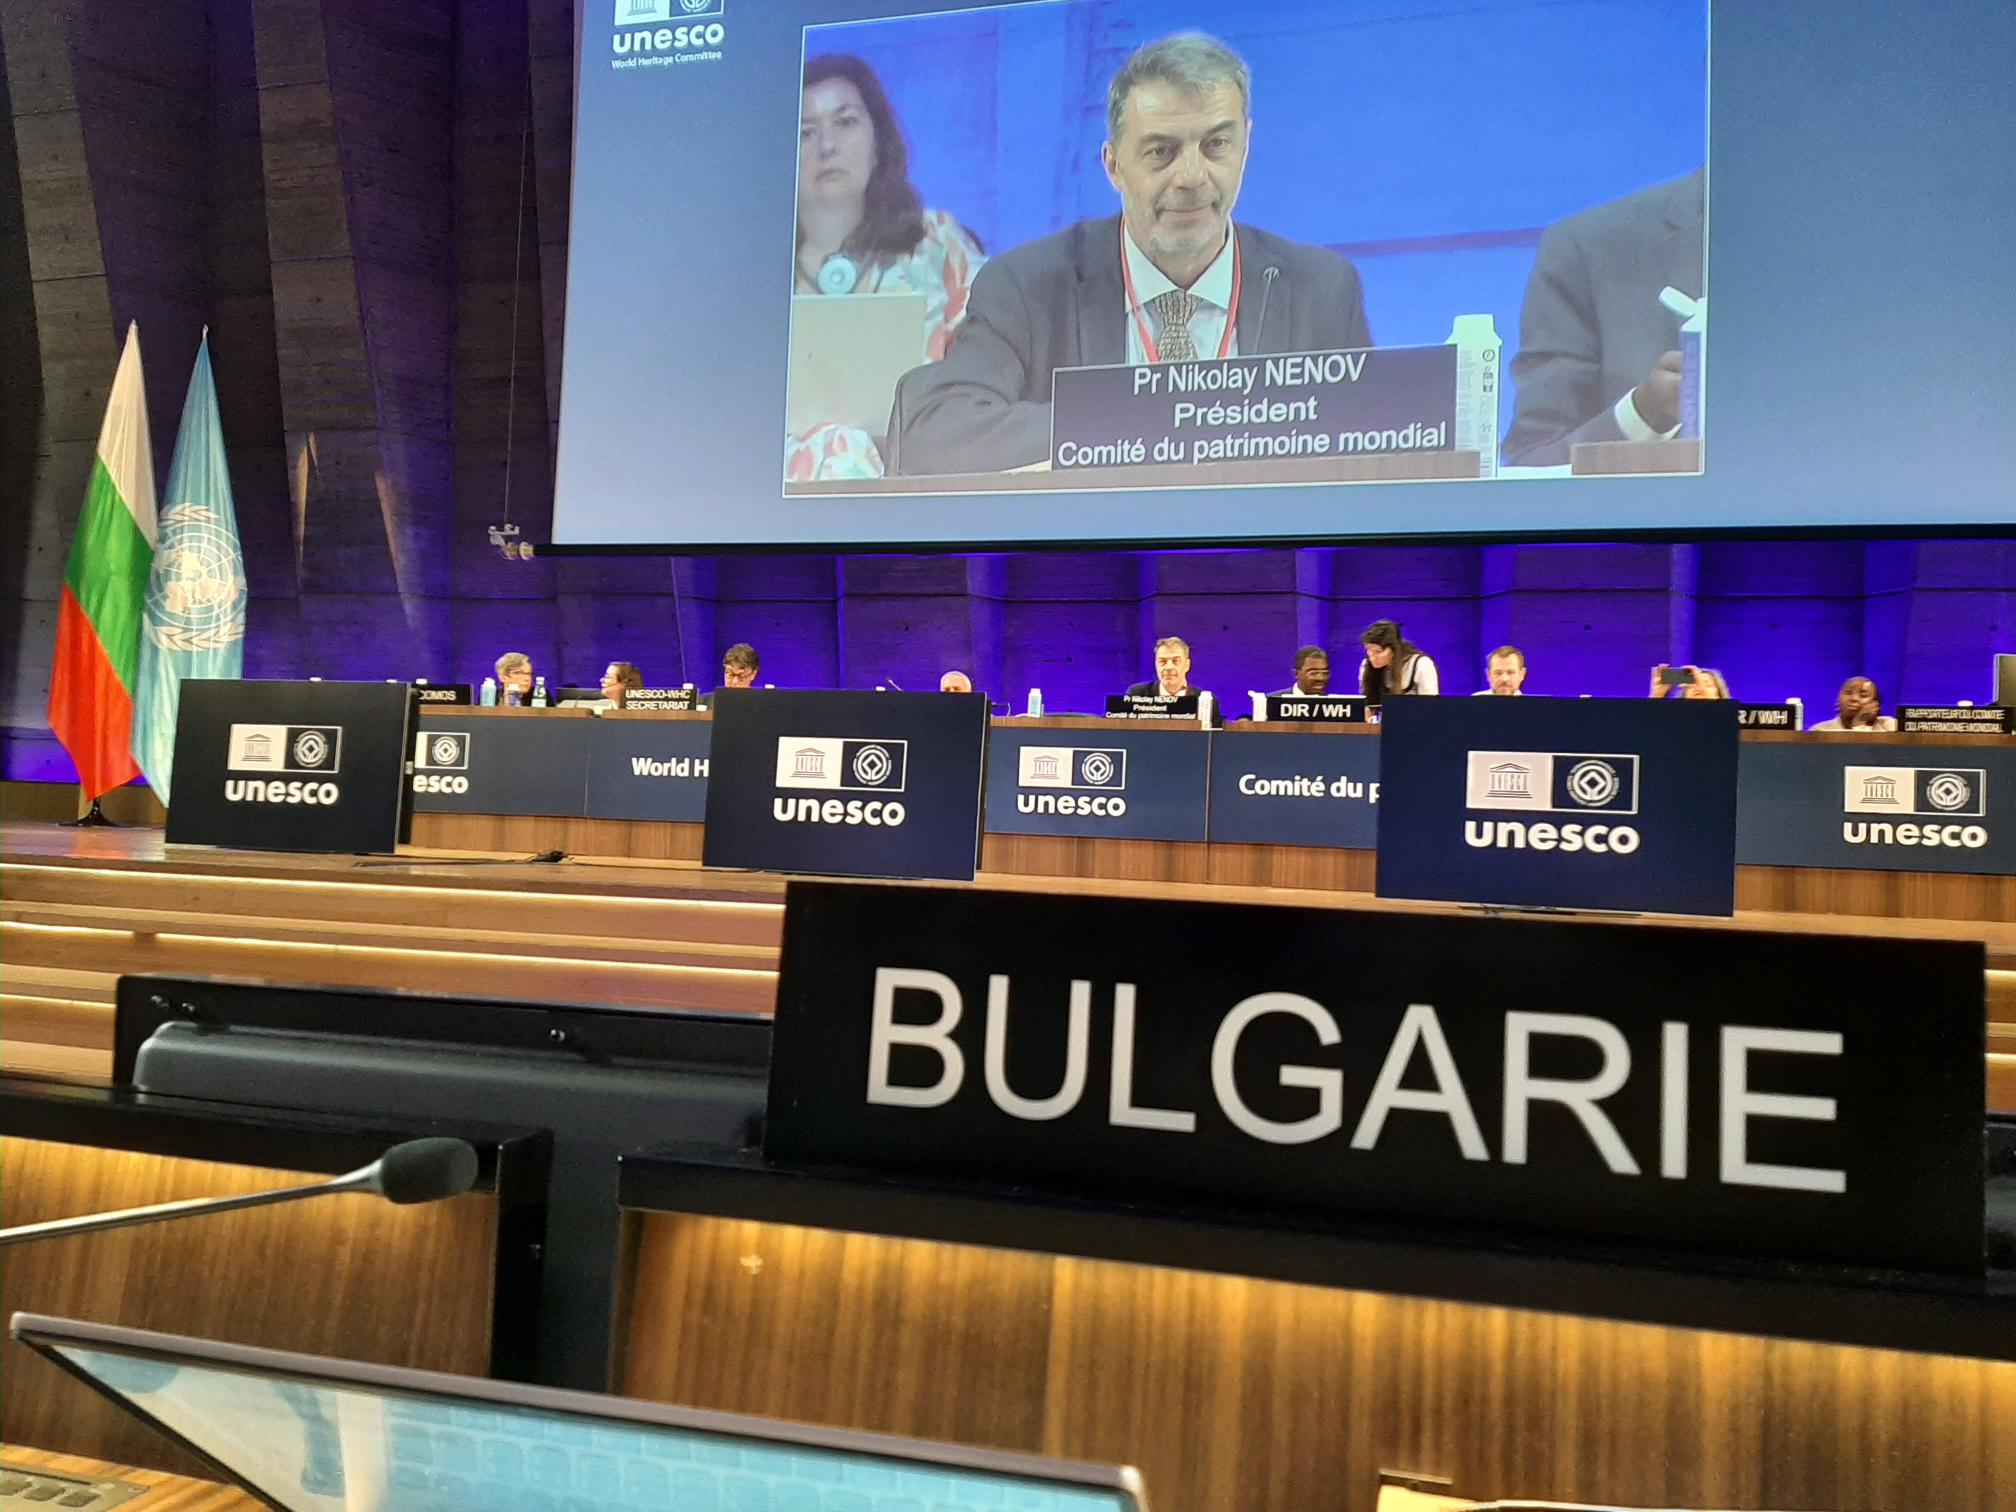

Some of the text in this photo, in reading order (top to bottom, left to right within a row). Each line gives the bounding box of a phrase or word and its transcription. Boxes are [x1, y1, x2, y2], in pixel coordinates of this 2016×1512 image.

[613, 23, 725, 53] unesco
[611, 51, 723, 69] World Heritage Committee
[1133, 353, 1367, 395] Pr Nikolay NENOV
[1174, 396, 1318, 428] Président
[1057, 421, 1447, 467] Comité du patrimoine mondial
[625, 689, 691, 699] UNESCO-WHC
[625, 701, 690, 710] SECRETARIAT
[1280, 703, 1351, 717] DIR / WH
[631, 757, 690, 777] World
[225, 780, 339, 805] unesco
[1238, 774, 1326, 797] Comité
[1330, 776, 1363, 798] du
[773, 797, 906, 827] unesco
[1017, 794, 1126, 817] unesco
[1464, 820, 1641, 854] unesco
[1843, 821, 1988, 848] unesco
[866, 966, 1846, 1193] BULGARIE
